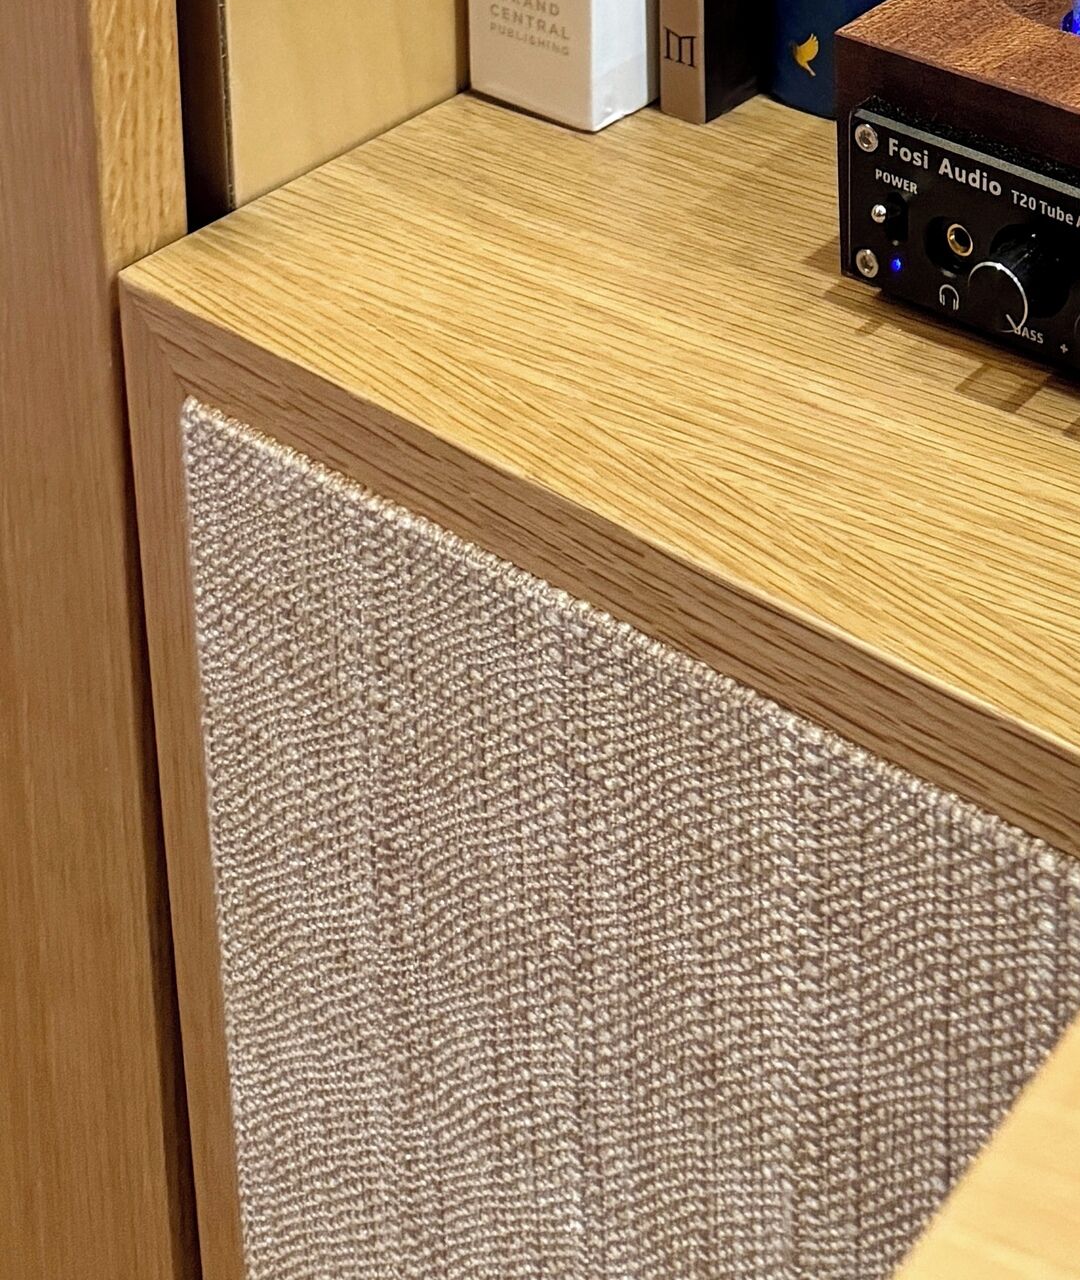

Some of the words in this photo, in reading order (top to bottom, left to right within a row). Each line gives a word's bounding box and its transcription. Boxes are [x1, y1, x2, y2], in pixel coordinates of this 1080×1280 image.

[490, 3, 570, 40] CENTRAL
[490, 22, 570, 56] PUBLISHING
[875, 168, 918, 195] POWER
[888, 137, 929, 169] Fosi
[938, 158, 1002, 196] Audio
[1011, 189, 1037, 211] T20
[1039, 200, 1074, 225] Tube
